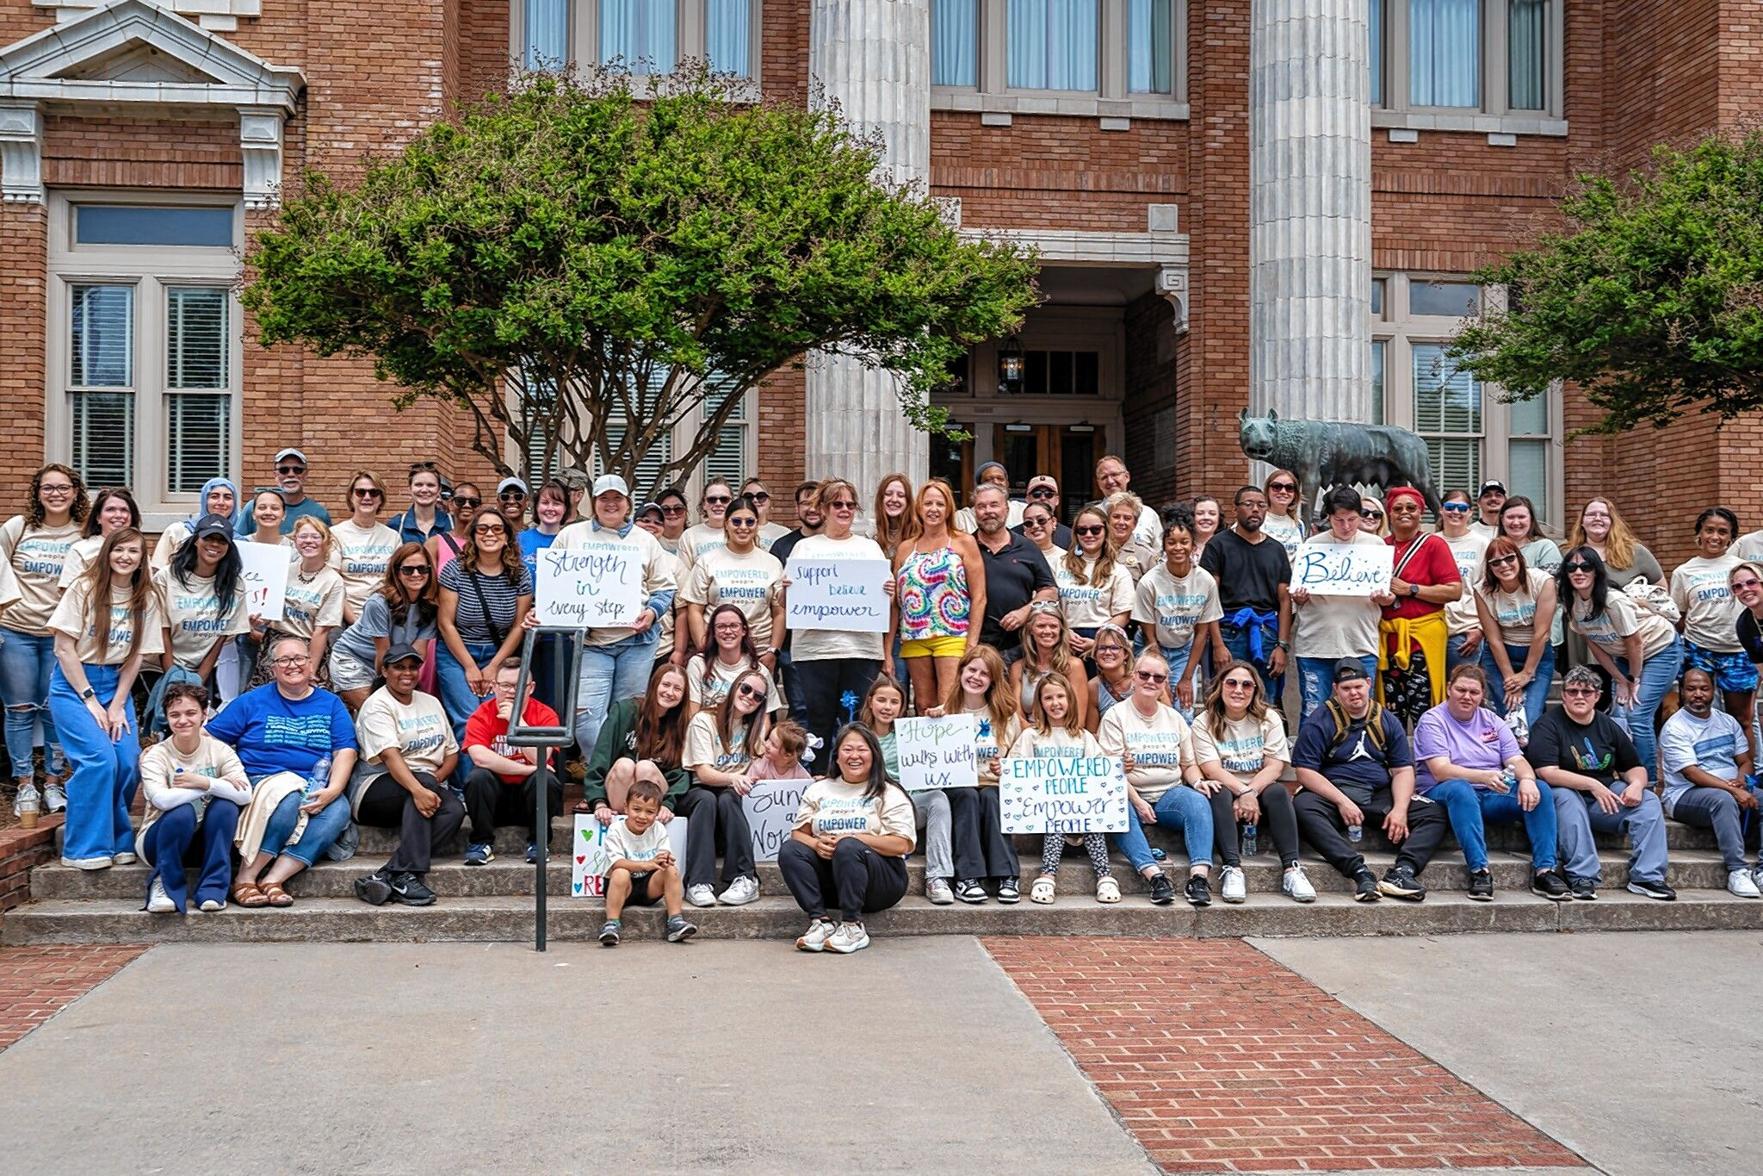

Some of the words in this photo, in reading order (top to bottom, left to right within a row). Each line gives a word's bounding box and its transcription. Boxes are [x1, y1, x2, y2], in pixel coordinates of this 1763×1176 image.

[544, 550, 628, 585] Strength
[715, 569, 770, 580] EMPOWERED
[795, 563, 839, 586] support
[1301, 552, 1386, 584] Believe
[576, 580, 600, 596] in
[720, 587, 766, 599] EMPOWER
[545, 600, 589, 623] every
[790, 604, 880, 621] empower
[902, 719, 964, 746] Hope
[943, 743, 975, 773] with
[1013, 757, 1112, 778] EMPOWERED
[1044, 777, 1089, 795] PEOPLE
[1022, 797, 1113, 820] Empower
[818, 817, 868, 832] EMPOWER
[1045, 818, 1092, 833] PEOPLE
